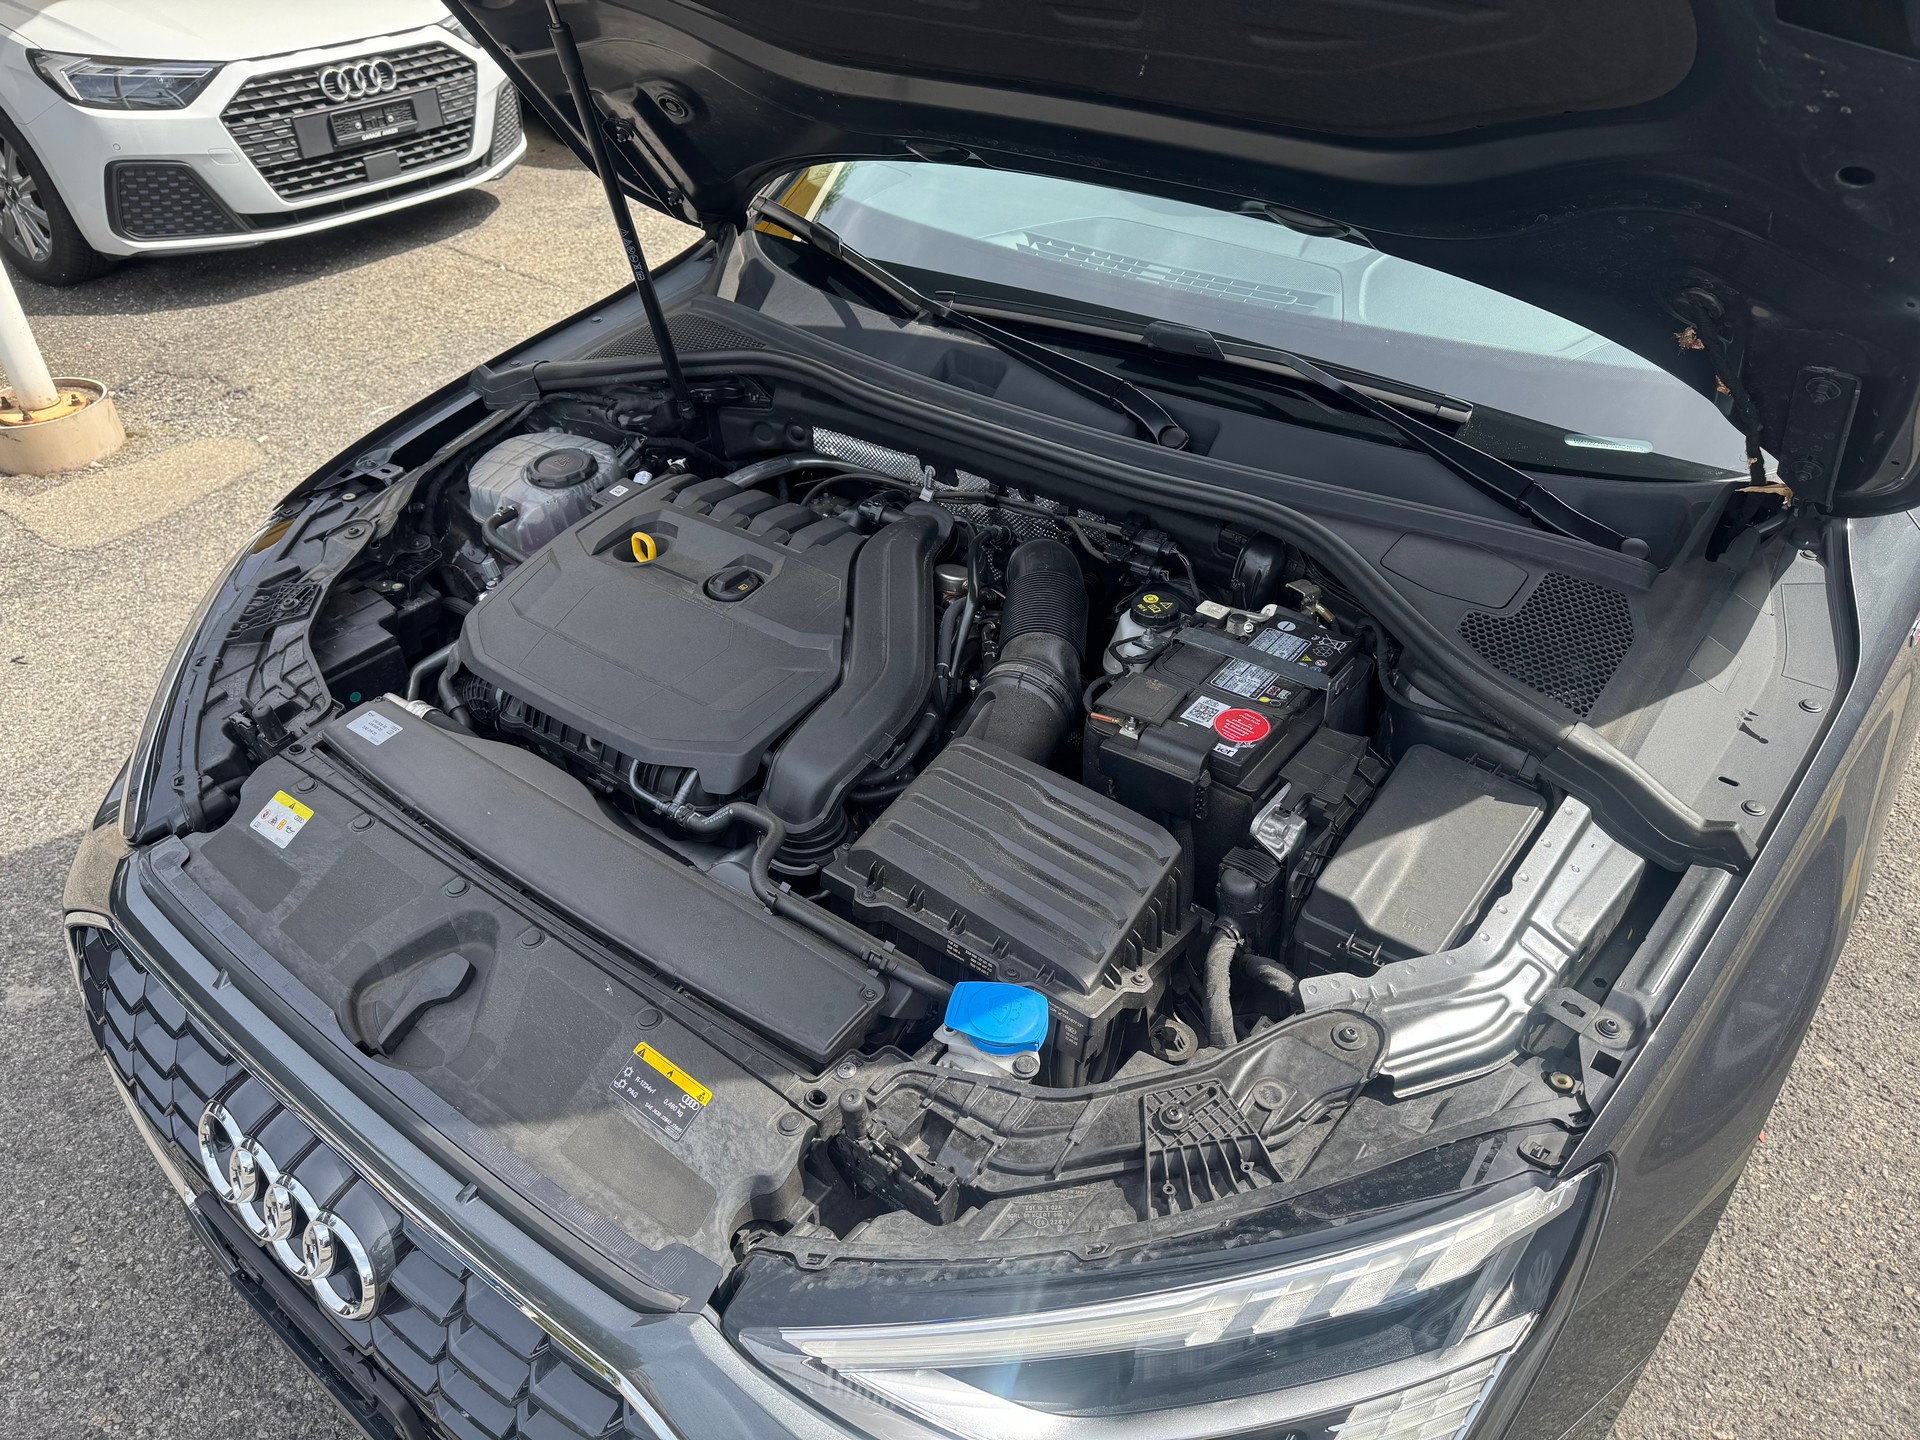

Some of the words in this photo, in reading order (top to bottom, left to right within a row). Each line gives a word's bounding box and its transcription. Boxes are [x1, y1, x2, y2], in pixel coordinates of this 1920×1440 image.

[627, 1087, 639, 1098] PAG
[635, 1076, 656, 1095] R-1234yf
[676, 1108, 684, 1118] kg
